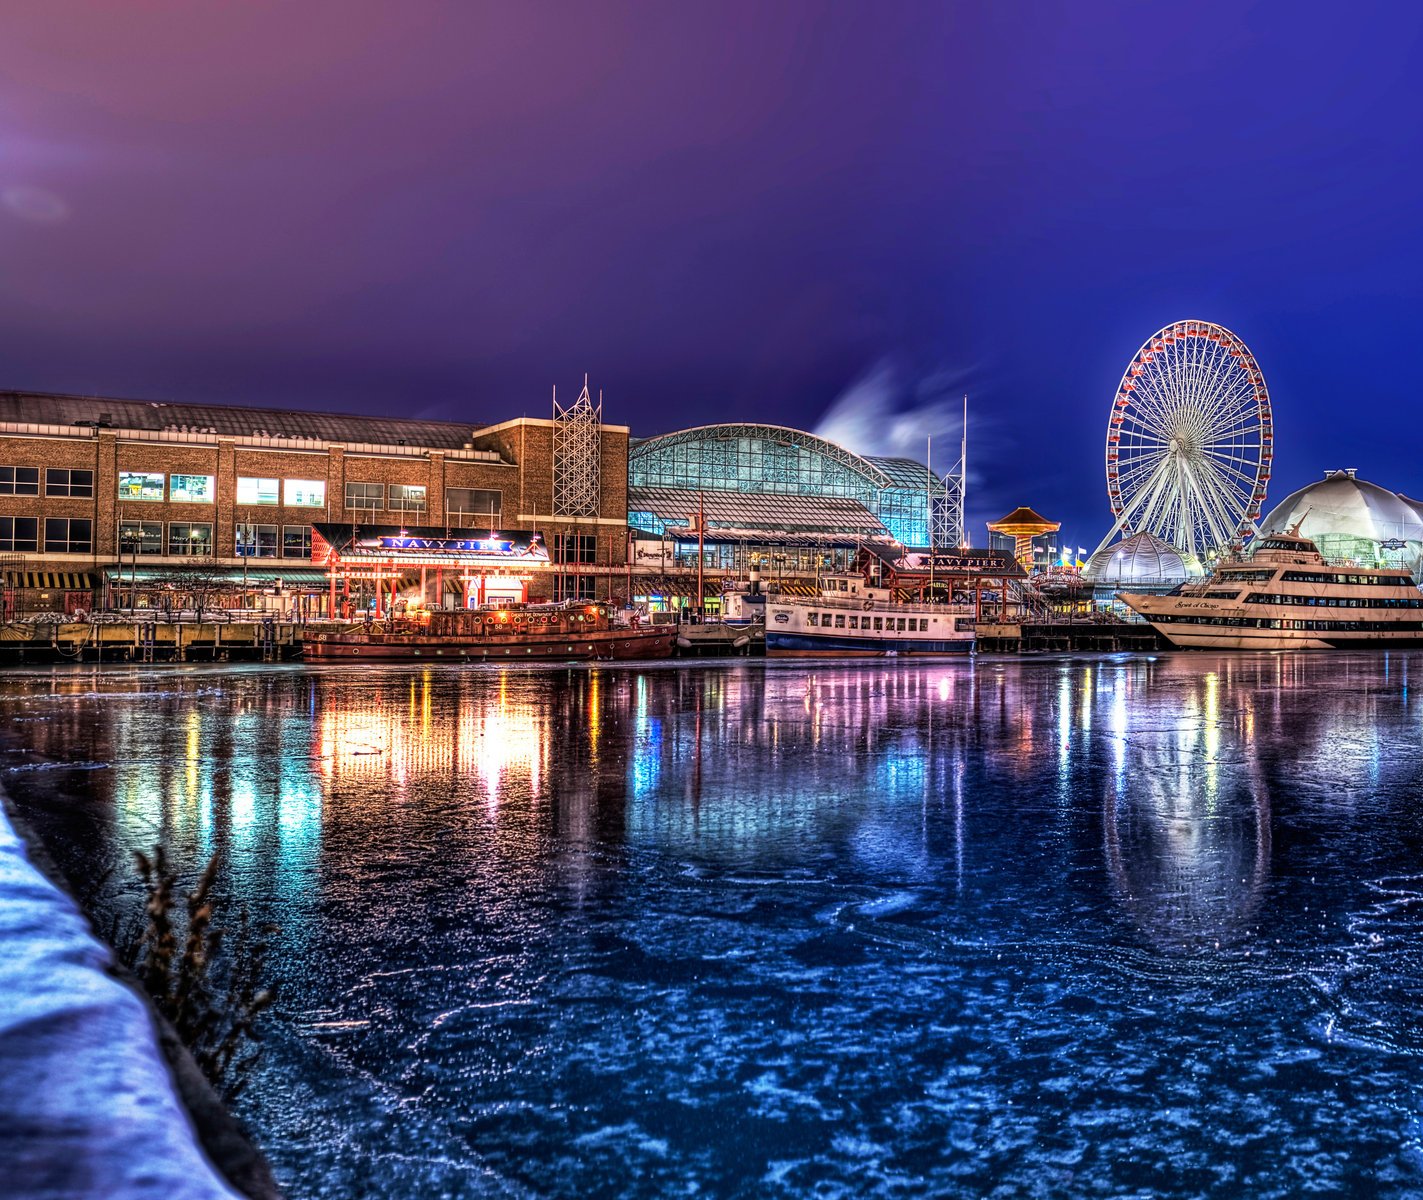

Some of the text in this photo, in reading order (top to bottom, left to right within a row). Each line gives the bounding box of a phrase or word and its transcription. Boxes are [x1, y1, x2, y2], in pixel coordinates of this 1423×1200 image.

[392, 539, 503, 550] NAVY PIER
[1174, 601, 1192, 609] Spirit
[1200, 602, 1219, 610] Chicago
